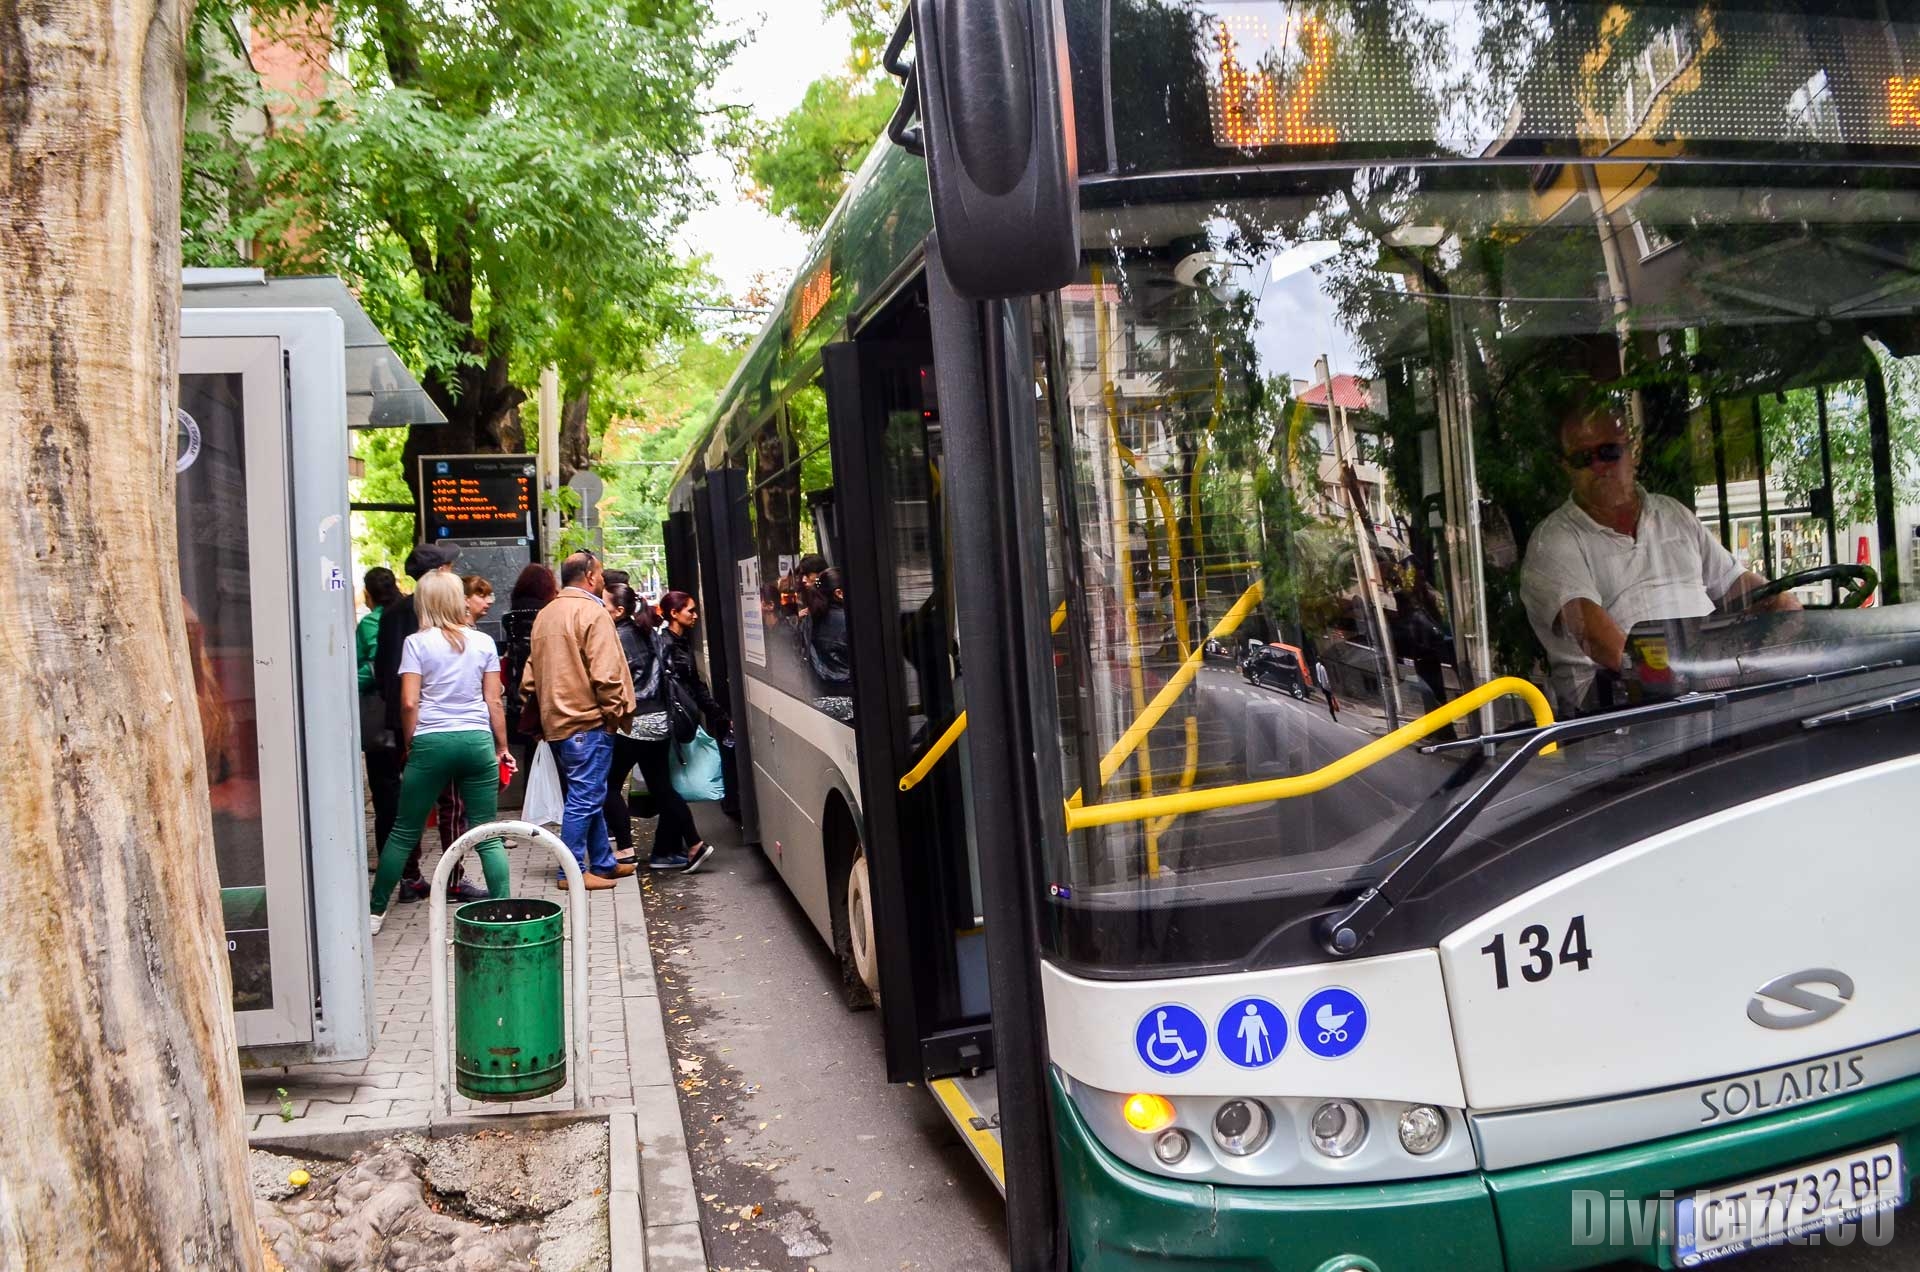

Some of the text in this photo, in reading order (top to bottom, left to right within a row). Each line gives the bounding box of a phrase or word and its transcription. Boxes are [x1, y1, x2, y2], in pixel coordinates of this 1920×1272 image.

[1219, 16, 1335, 144] 62
[1481, 915, 1592, 989] 134
[1701, 1056, 1864, 1123] SOLARIS
[1702, 1191, 1747, 1241] CT
[1756, 1168, 1841, 1230] 7732
[1849, 1154, 1893, 1202] BP
